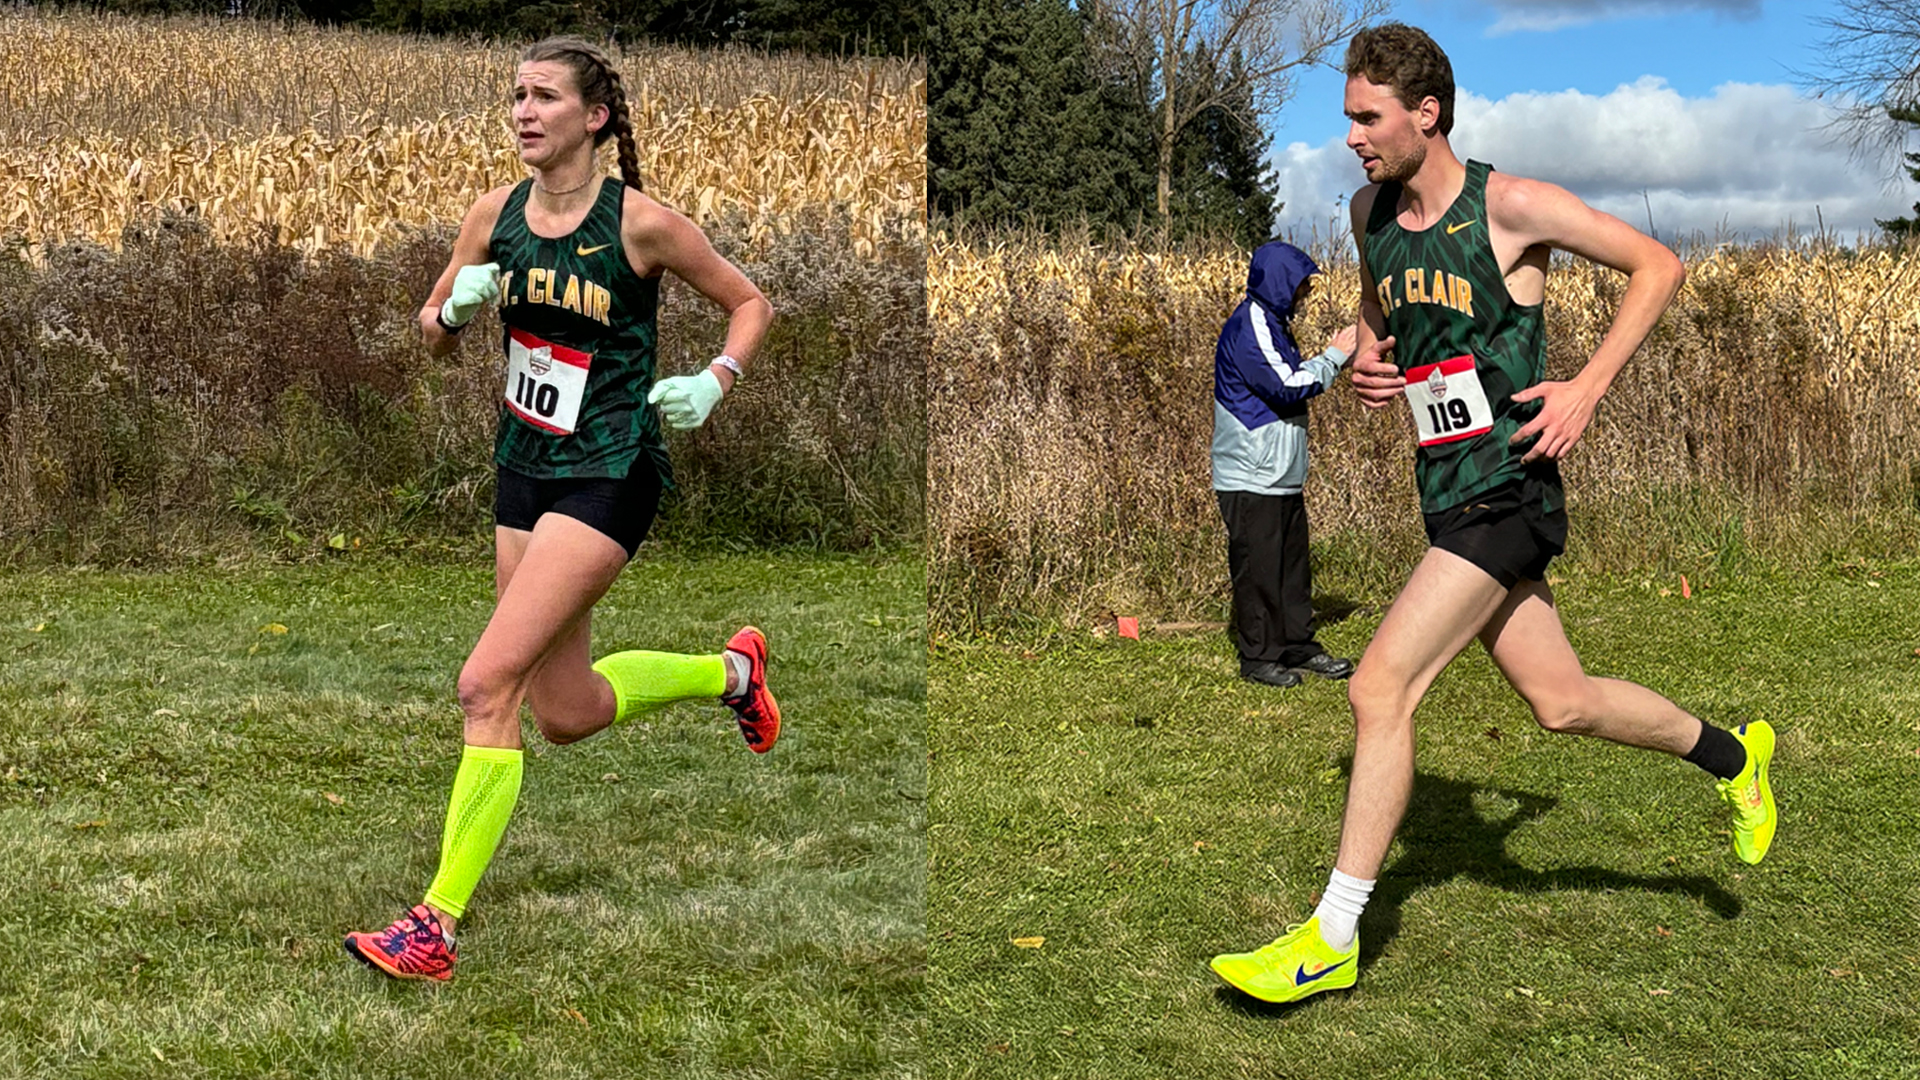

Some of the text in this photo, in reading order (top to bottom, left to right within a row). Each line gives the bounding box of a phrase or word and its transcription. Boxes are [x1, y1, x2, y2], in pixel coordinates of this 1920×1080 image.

[527, 267, 611, 327] CLAIR
[1405, 267, 1475, 318] CLAIR
[515, 371, 560, 418] 110
[1427, 397, 1472, 434] 119
